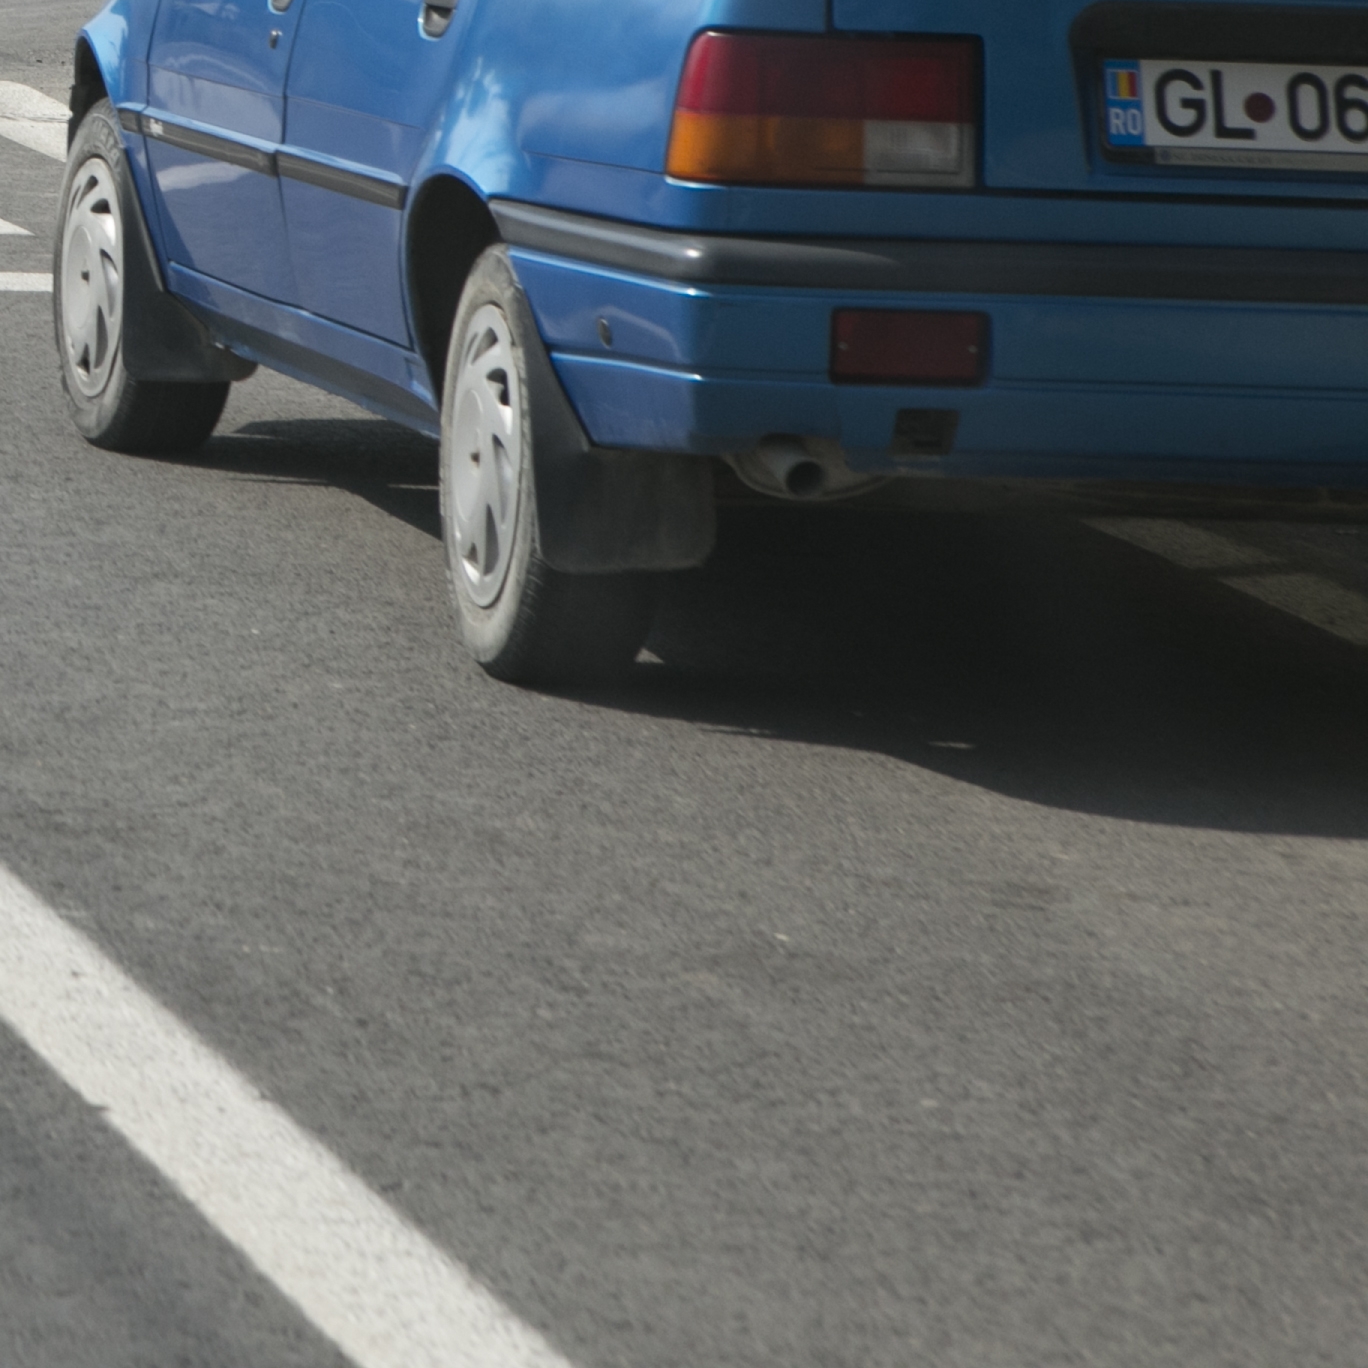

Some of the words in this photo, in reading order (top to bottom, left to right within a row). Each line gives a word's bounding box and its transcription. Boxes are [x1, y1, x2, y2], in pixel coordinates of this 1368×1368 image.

[1109, 107, 1142, 136] RO
[1155, 68, 1257, 140] GL
[1286, 72, 1368, 144] 06
